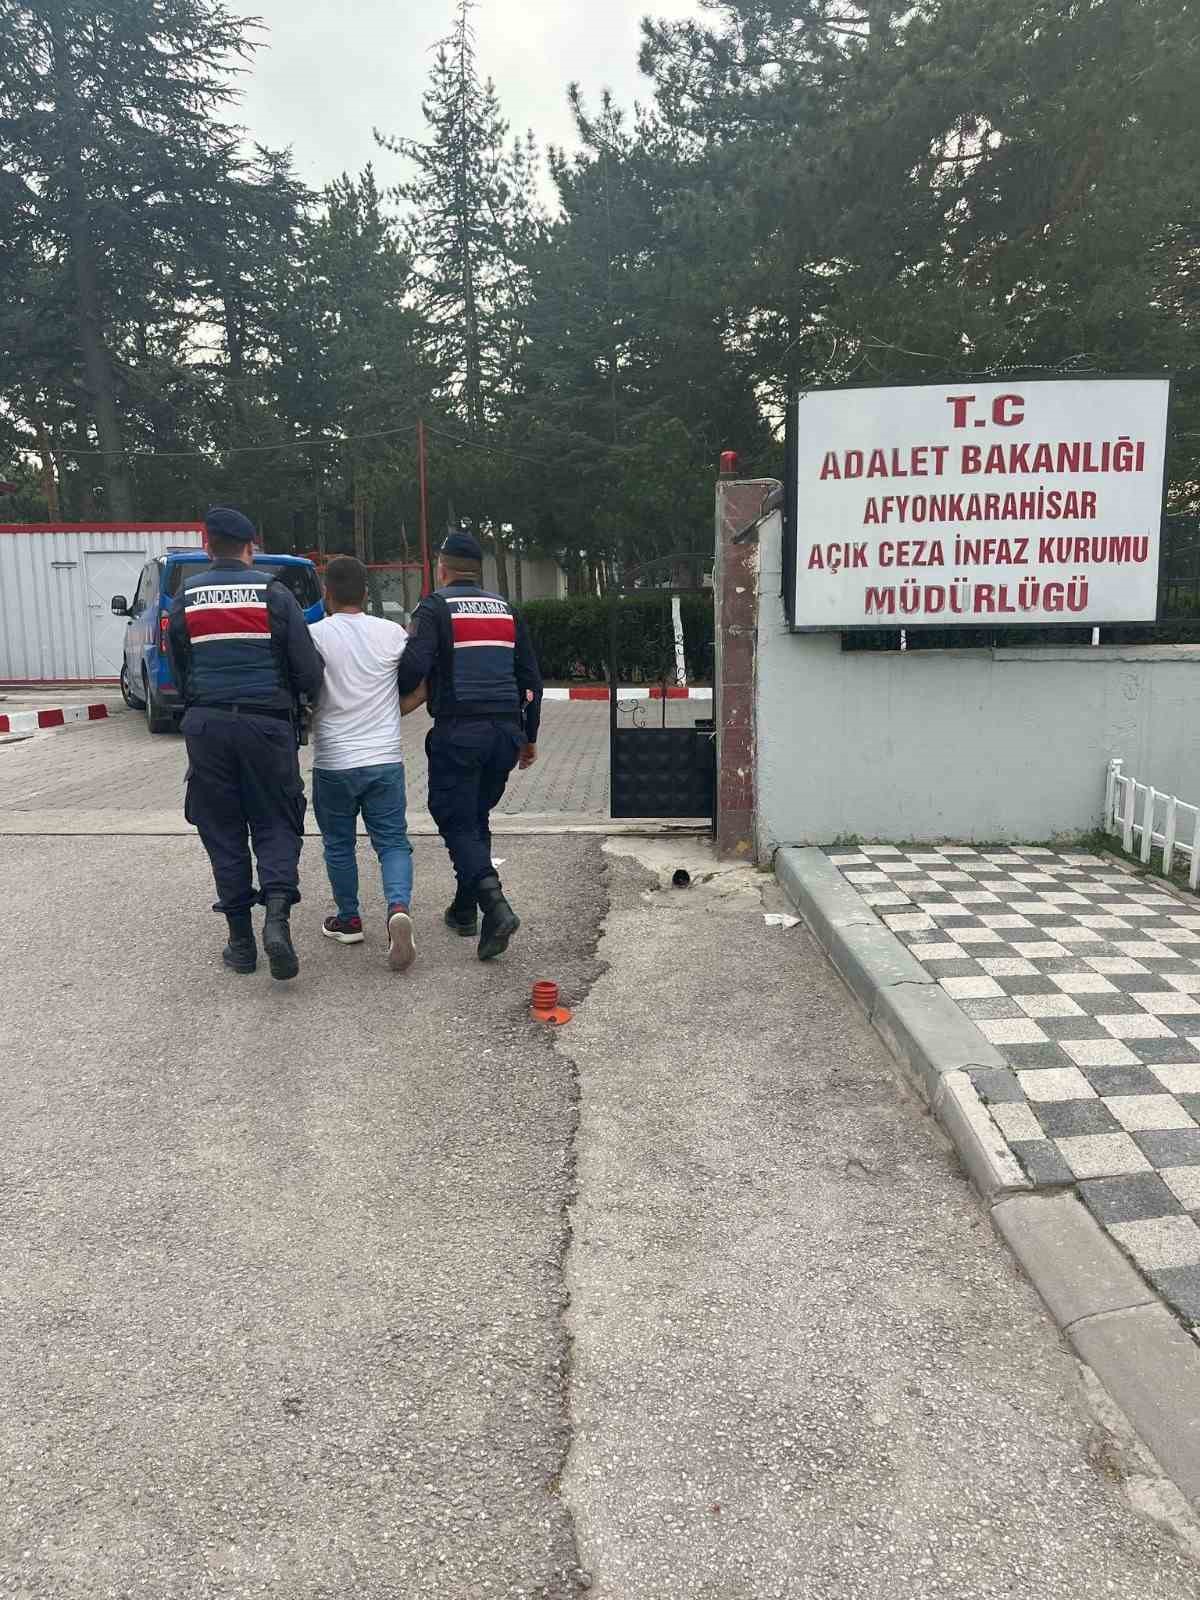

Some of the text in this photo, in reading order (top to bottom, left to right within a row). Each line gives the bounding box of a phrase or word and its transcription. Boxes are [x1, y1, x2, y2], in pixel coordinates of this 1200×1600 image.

[946, 394, 1025, 428] T.C
[819, 436, 1146, 480] ADALET BAKANLIĞI
[863, 485, 1097, 524] AFYONKARAHİSAR
[807, 533, 1149, 575] AÇIK CEZA İNFAZ KURUMU
[193, 589, 259, 605] JANDARMA
[457, 601, 507, 614] JANDARMA
